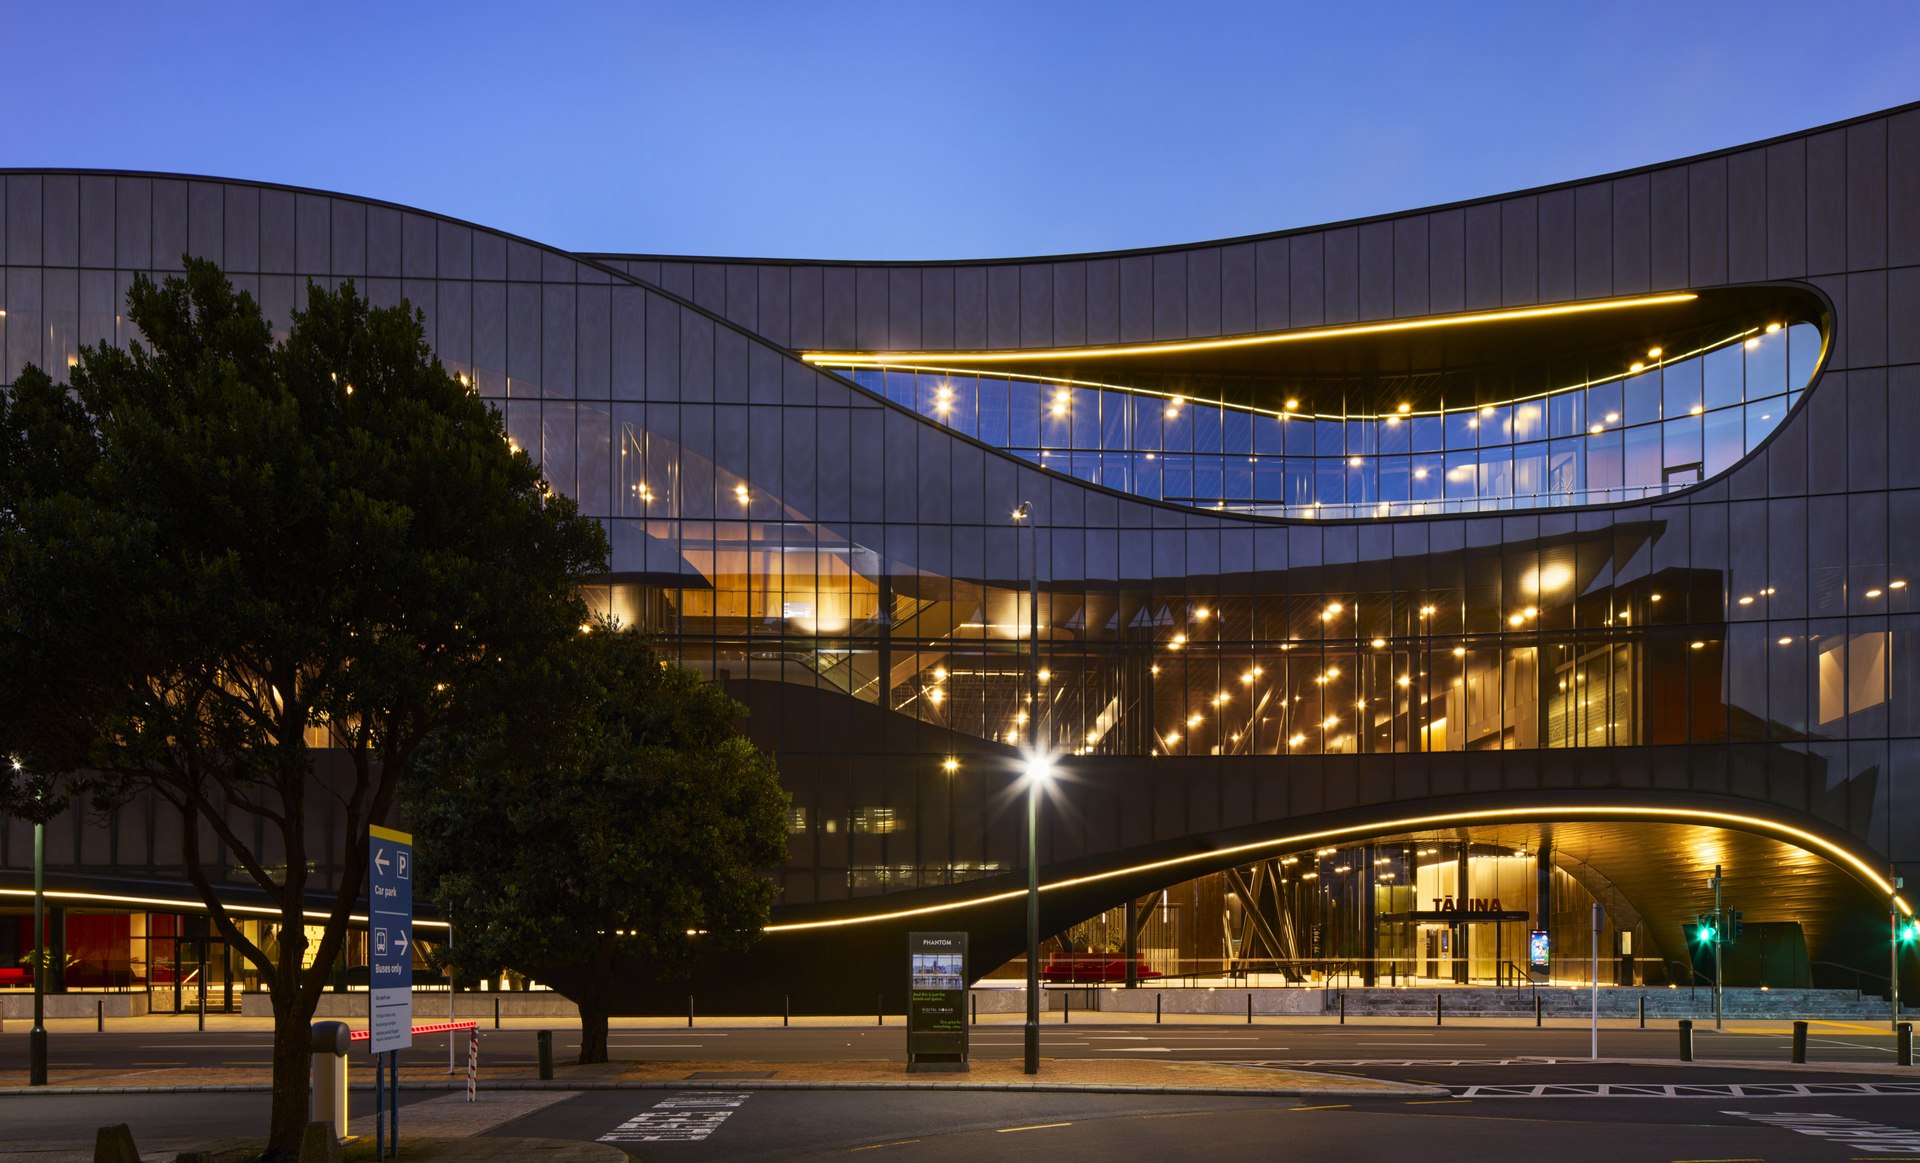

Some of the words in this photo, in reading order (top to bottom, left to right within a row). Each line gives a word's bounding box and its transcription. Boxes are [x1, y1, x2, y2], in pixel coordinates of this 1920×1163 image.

[399, 855, 407, 875] P
[375, 885, 384, 895] Car
[385, 886, 397, 899] park
[375, 963, 391, 973] Buses
[391, 962, 402, 975] only
